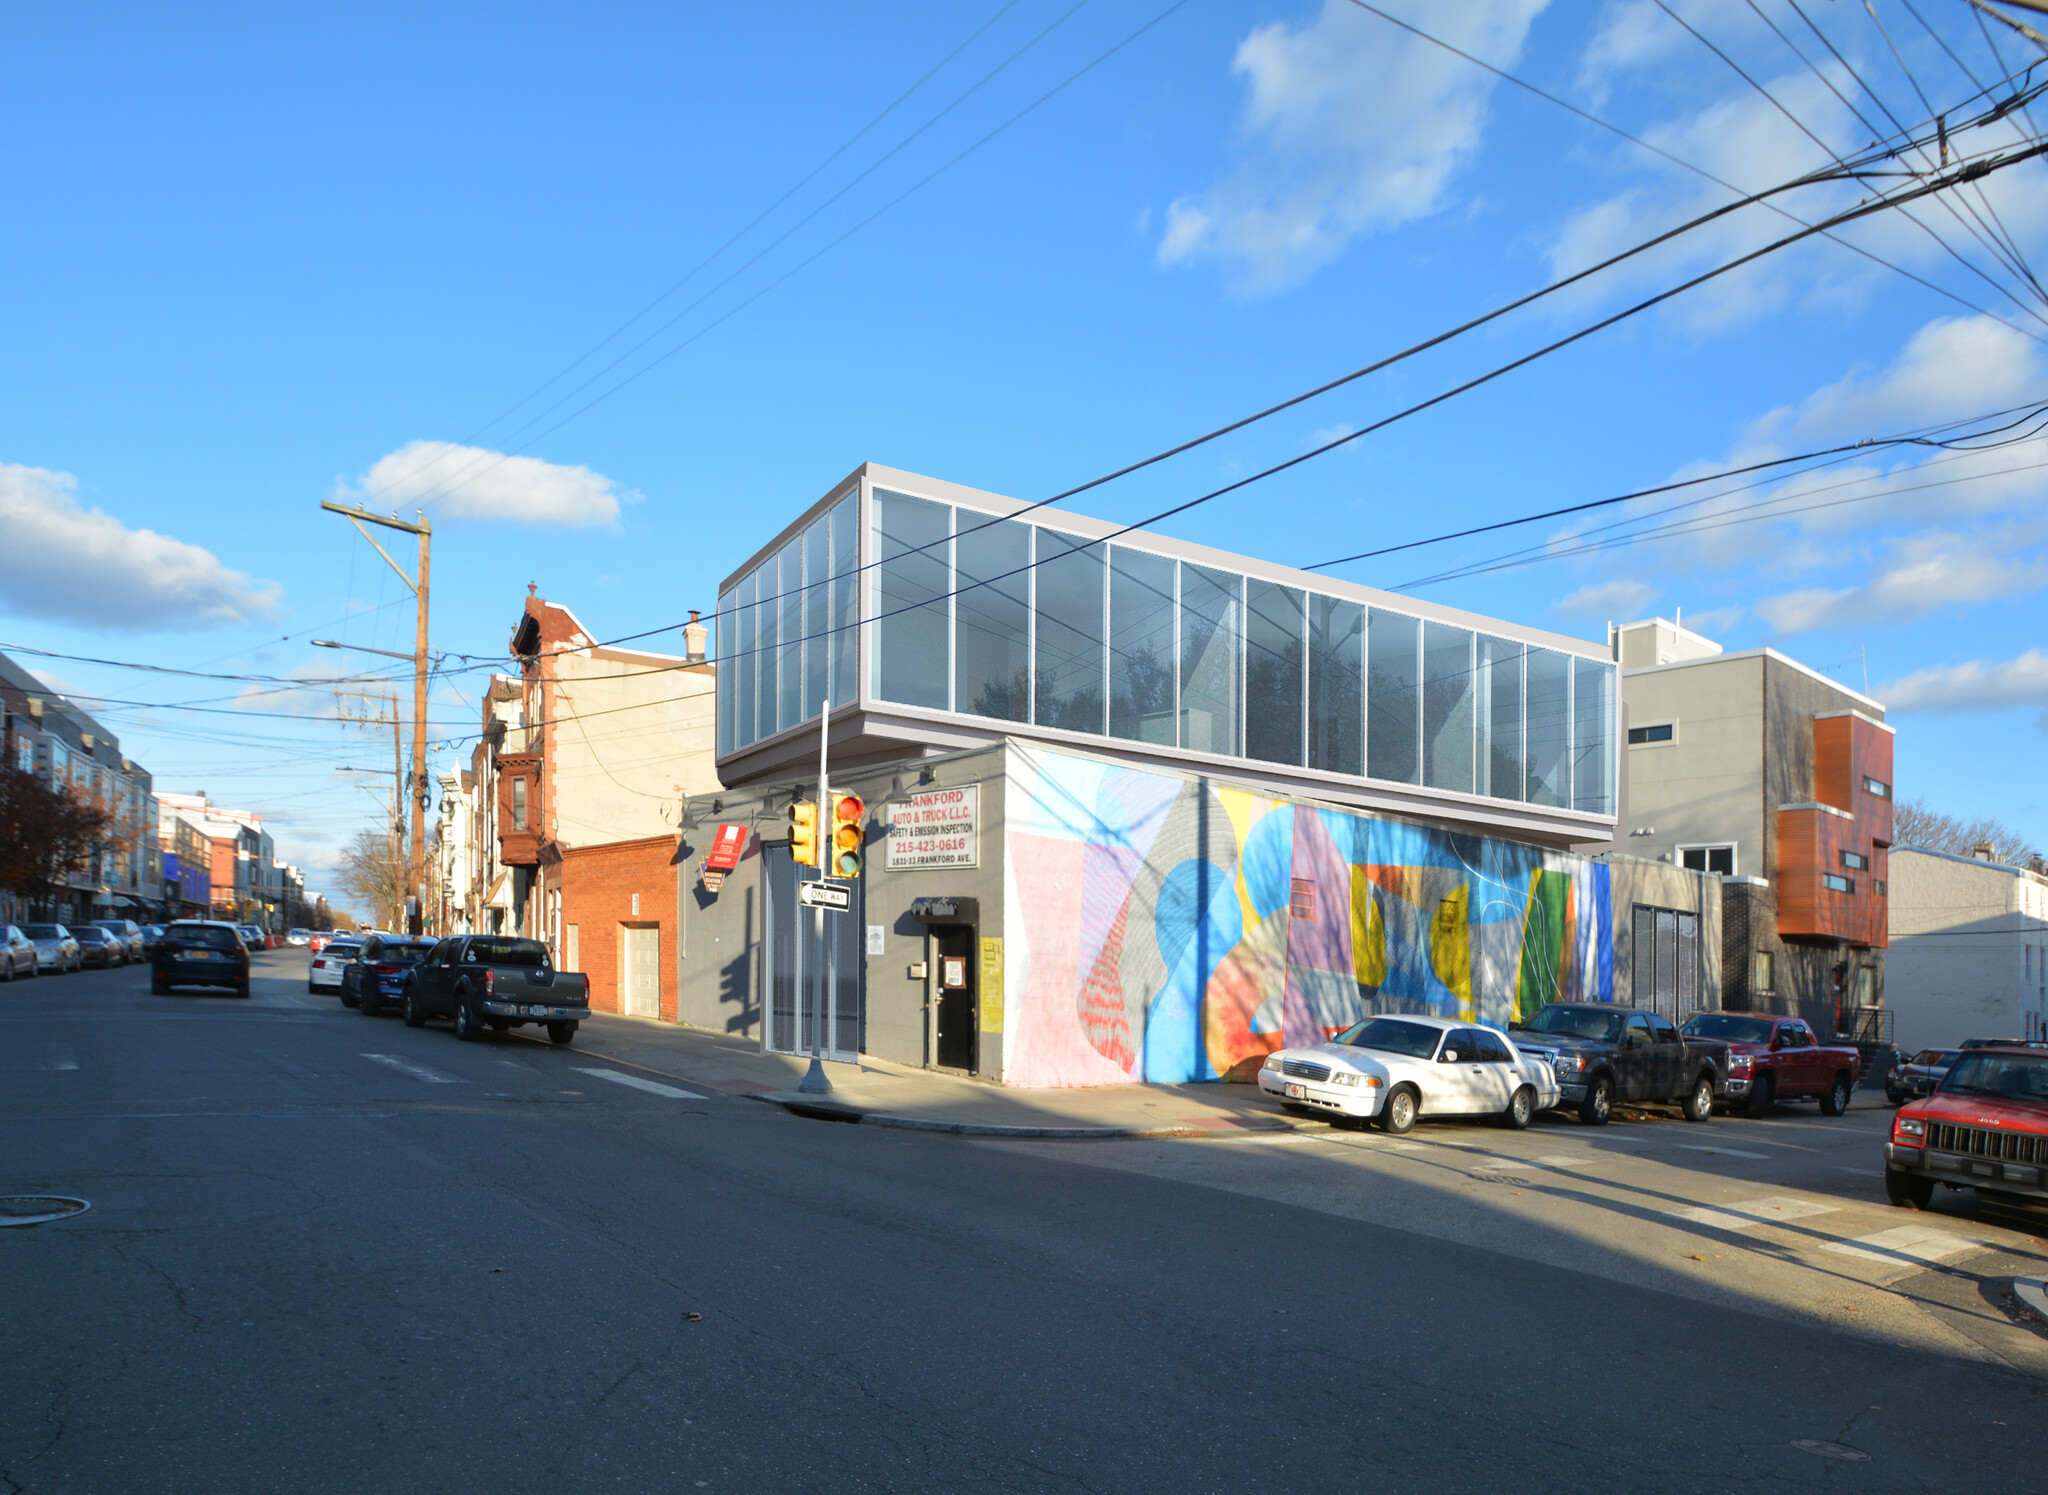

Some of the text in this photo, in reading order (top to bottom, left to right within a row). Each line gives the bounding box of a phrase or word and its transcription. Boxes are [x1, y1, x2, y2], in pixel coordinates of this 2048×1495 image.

[892, 806, 971, 825] AUTO & TRUCK L.L.C.
[889, 823, 973, 838] SAFETY & EMISSION INSPECTION
[896, 838, 965, 853] 215-423-0616
[892, 853, 972, 866] 1831-33 FRANKFORD AVE.
[811, 889, 844, 903] ONE WAY
[1977, 1117, 2000, 1125] Jeep
